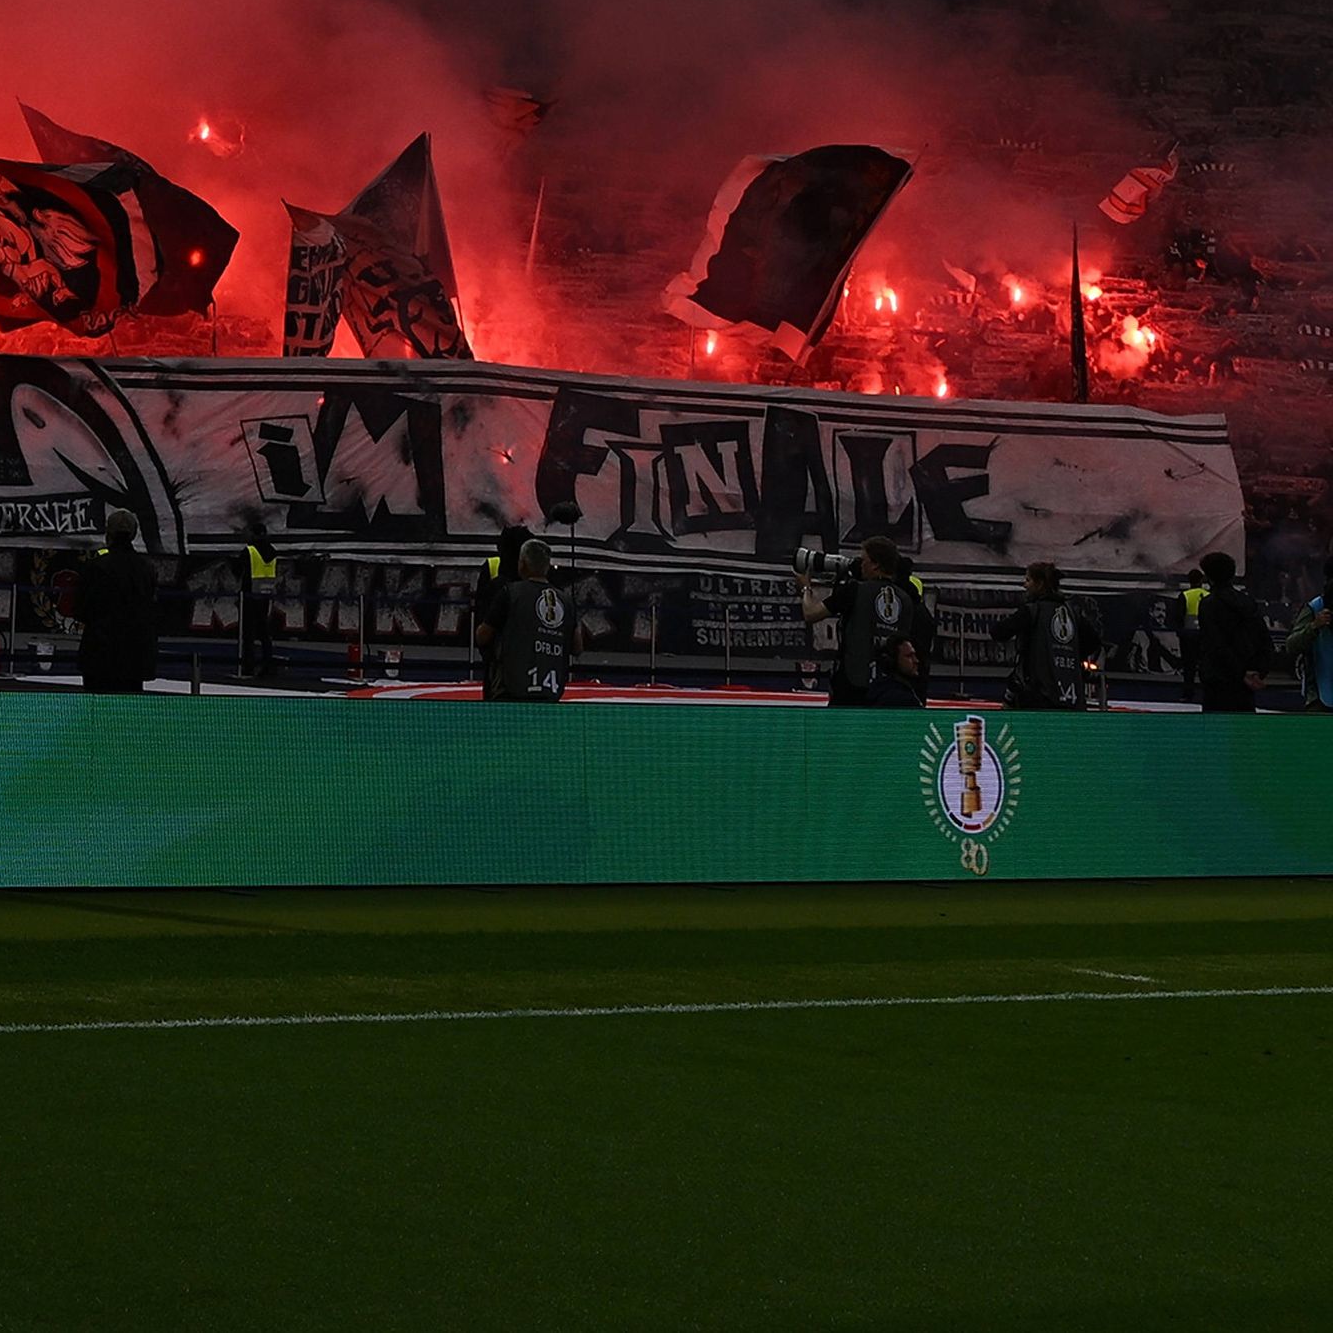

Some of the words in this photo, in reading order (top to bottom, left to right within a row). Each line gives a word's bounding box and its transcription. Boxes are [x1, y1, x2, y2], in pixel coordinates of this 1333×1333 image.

[699, 575, 798, 596] ULTRAS
[535, 639, 564, 657] DFB.D
[527, 666, 560, 694] 14
[961, 837, 989, 876] 80
